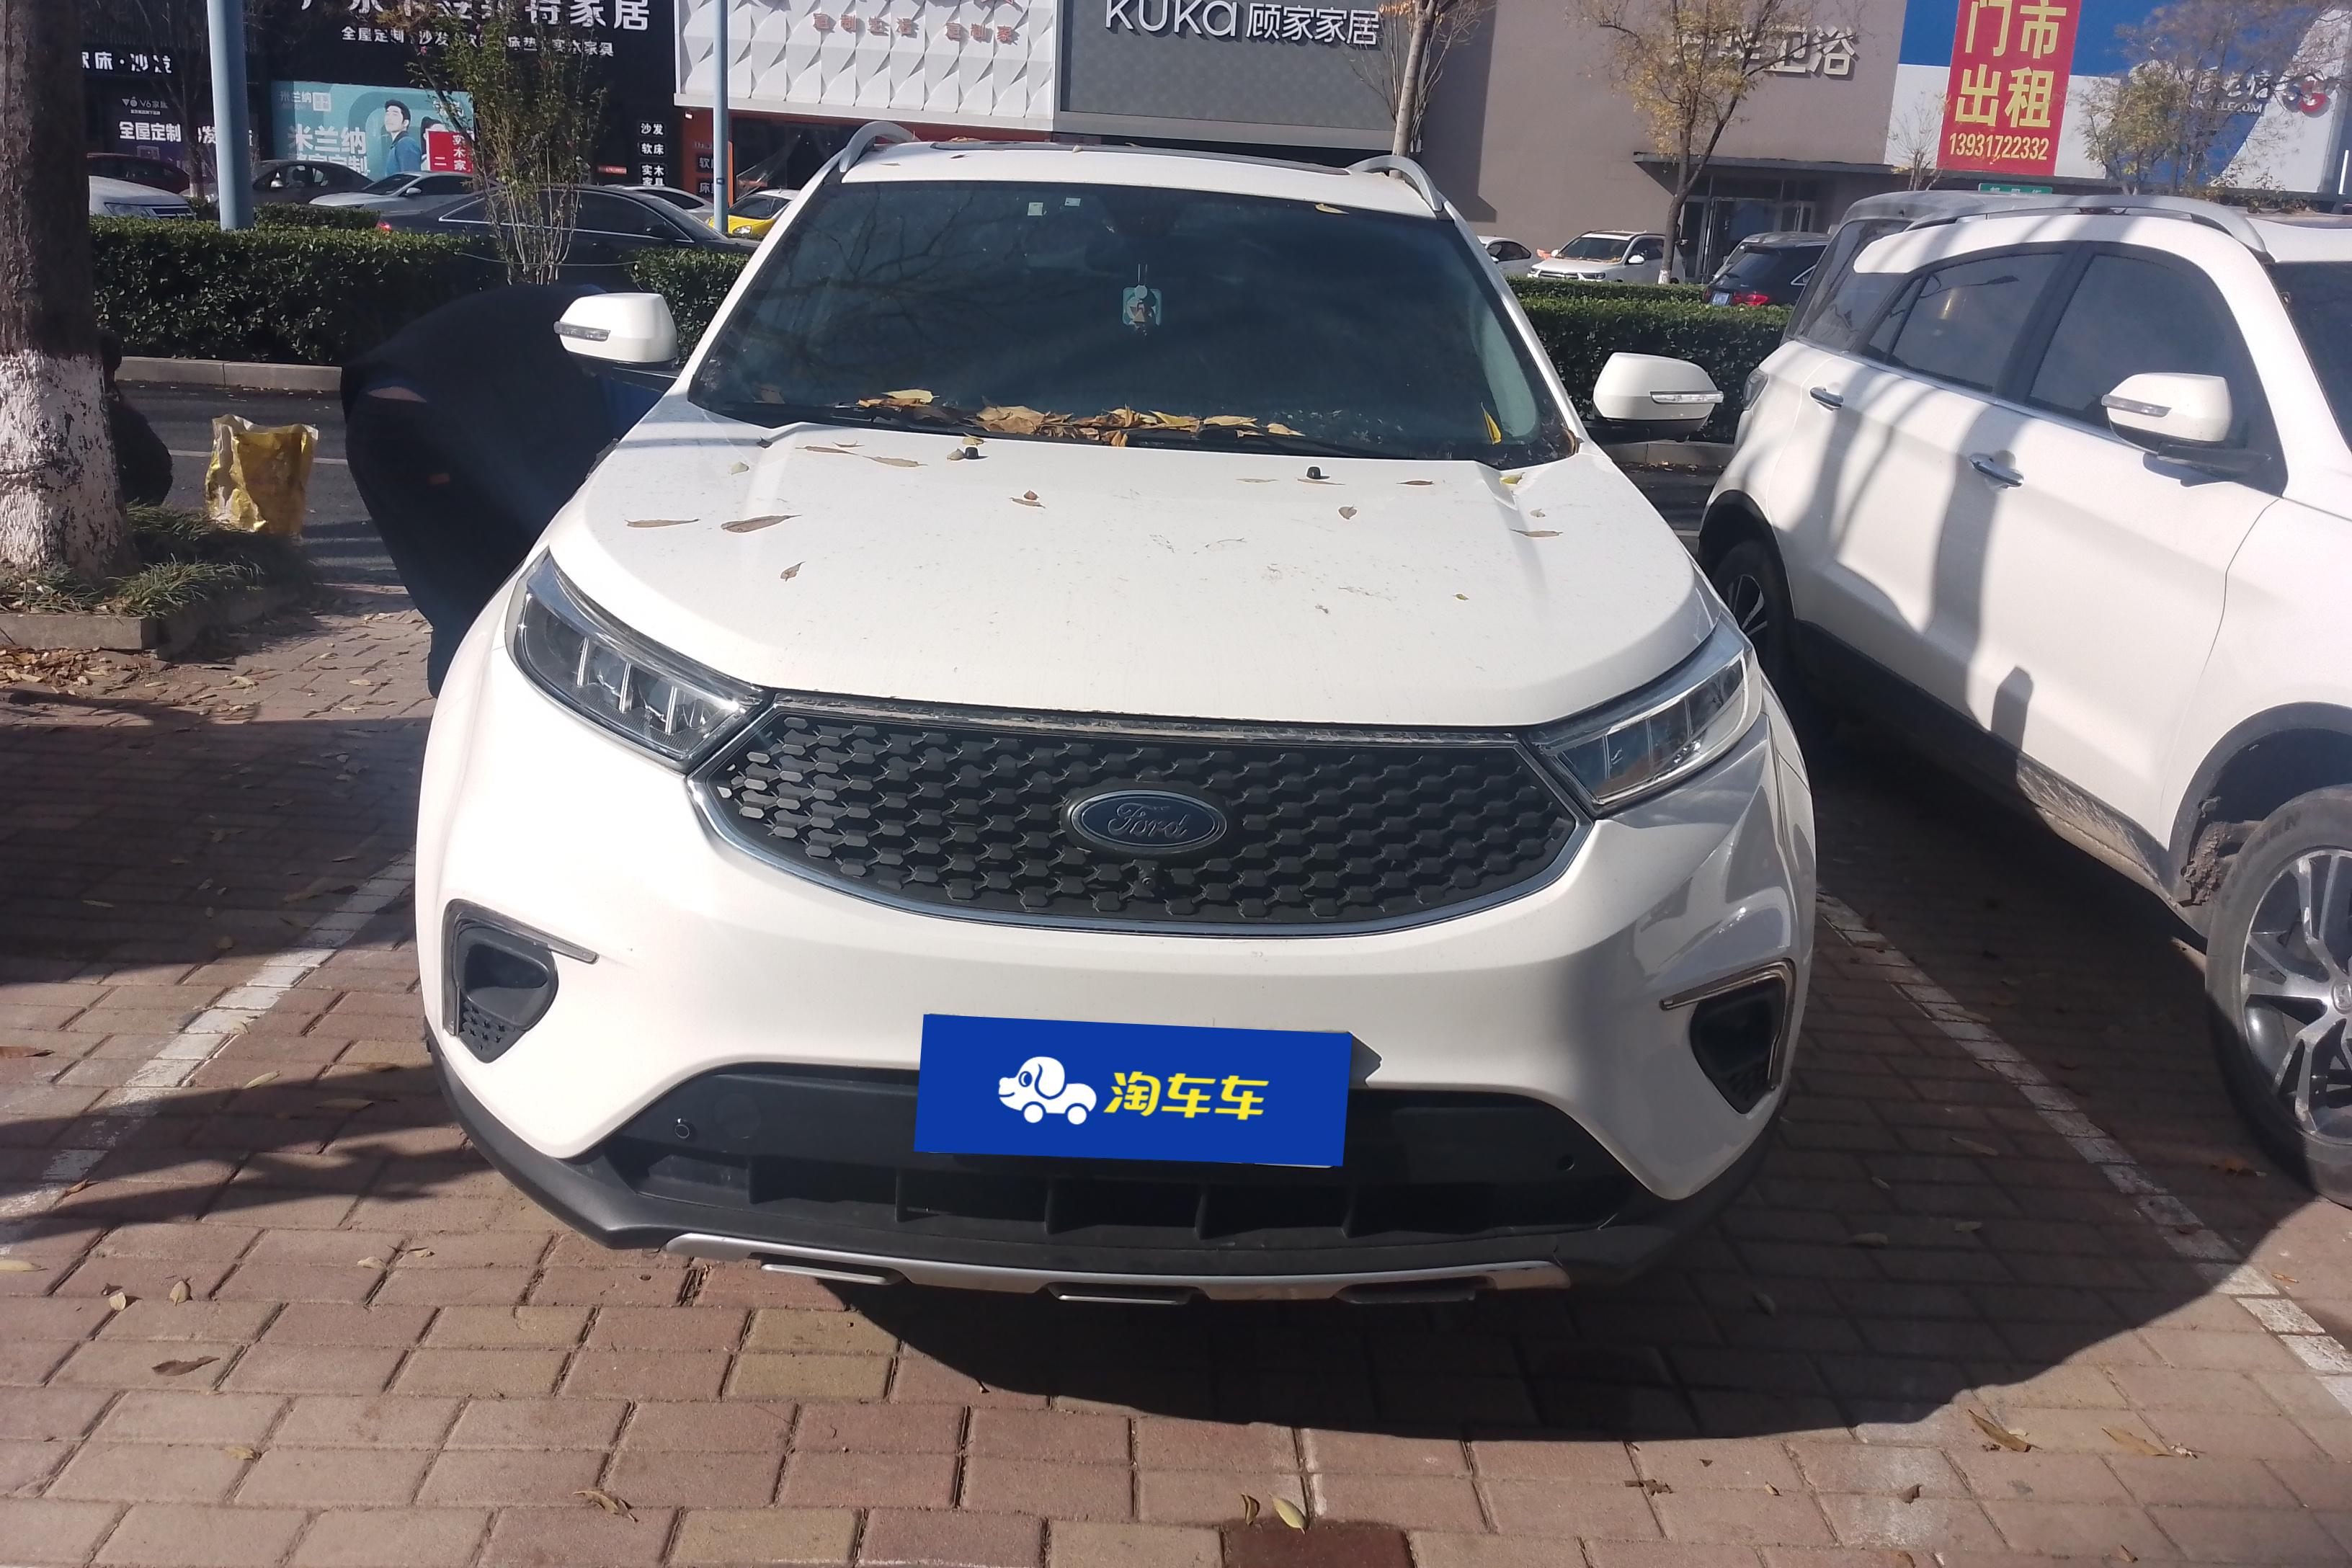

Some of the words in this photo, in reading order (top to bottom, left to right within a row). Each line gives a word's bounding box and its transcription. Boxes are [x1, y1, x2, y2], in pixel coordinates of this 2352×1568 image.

[1245, 2, 1380, 45] 顾家家居
[1964, 0, 2067, 59] 门市
[1954, 63, 2054, 128] 出租
[118, 121, 182, 143] 全屋定制
[288, 123, 367, 155] 米兰纳
[641, 122, 664, 135] 沙发
[641, 143, 664, 156] 软床
[1948, 132, 2050, 161] 13931722332
[641, 164, 664, 177] 实木
[699, 157, 714, 169] 软
[1108, 802, 1188, 839] Ford
